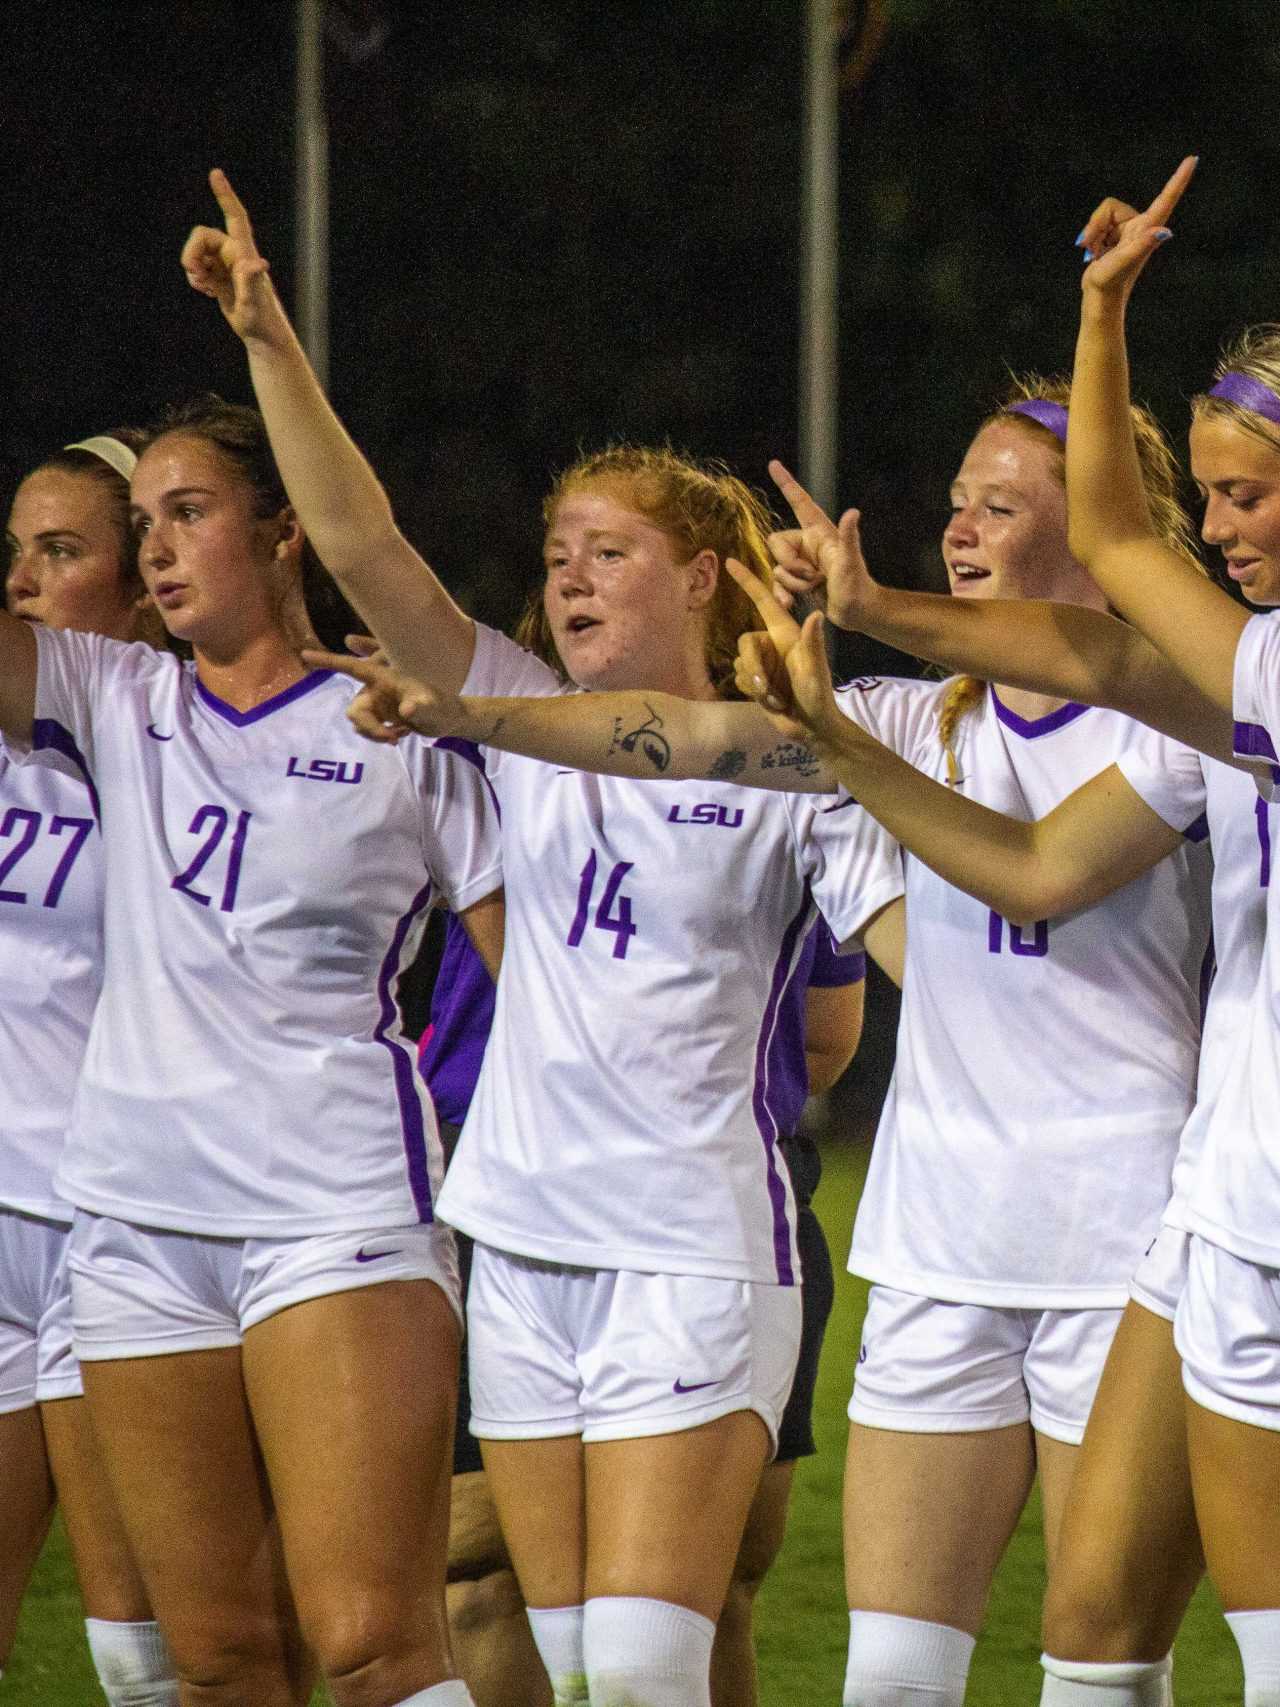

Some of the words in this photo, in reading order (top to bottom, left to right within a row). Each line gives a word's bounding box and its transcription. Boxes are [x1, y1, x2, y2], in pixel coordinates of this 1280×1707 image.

[286, 757, 364, 785] LSU
[667, 803, 744, 828] LSU
[0, 807, 94, 909] 27
[171, 804, 252, 912] 21
[567, 848, 636, 960] 14
